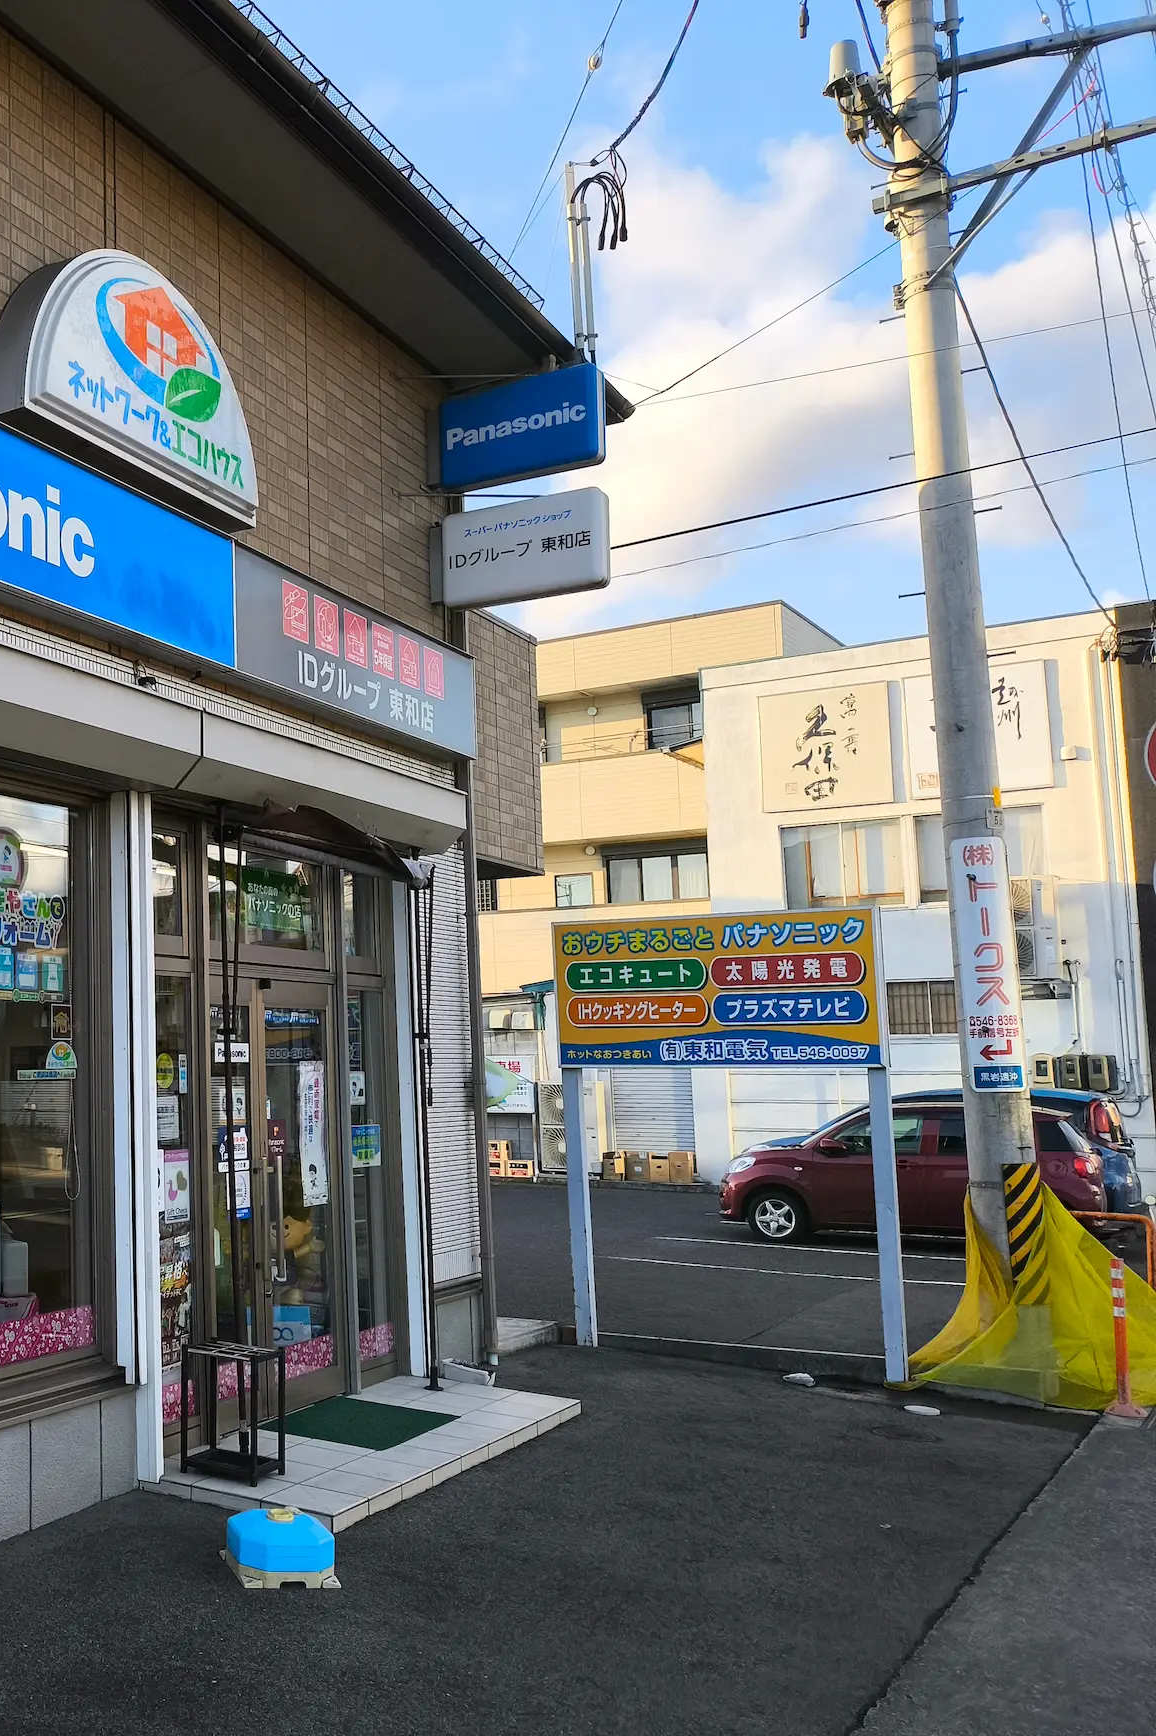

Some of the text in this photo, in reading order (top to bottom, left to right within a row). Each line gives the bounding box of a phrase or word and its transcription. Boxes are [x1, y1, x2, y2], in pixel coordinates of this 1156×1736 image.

[67, 360, 244, 489] ネットワーク&エコハウス
[446, 402, 586, 450] Panasonic
[449, 530, 591, 569] IDグループ 東和店
[297, 650, 434, 733] IDグループ 東和店
[248, 896, 301, 919] パナソニックの店
[562, 917, 866, 956] おウチまるごと パナソニック
[580, 957, 848, 985] エコキュート 太陽光発電
[578, 996, 851, 1021] IHクッキングヒーター プラズマテレビ
[976, 1014, 1019, 1026] 546-8368
[217, 1047, 247, 1059] Pasonic
[567, 1049, 652, 1060] ホットなおつきあい
[659, 1038, 768, 1062] (有)東和電気
[166, 1206, 188, 1216] Gift Check
